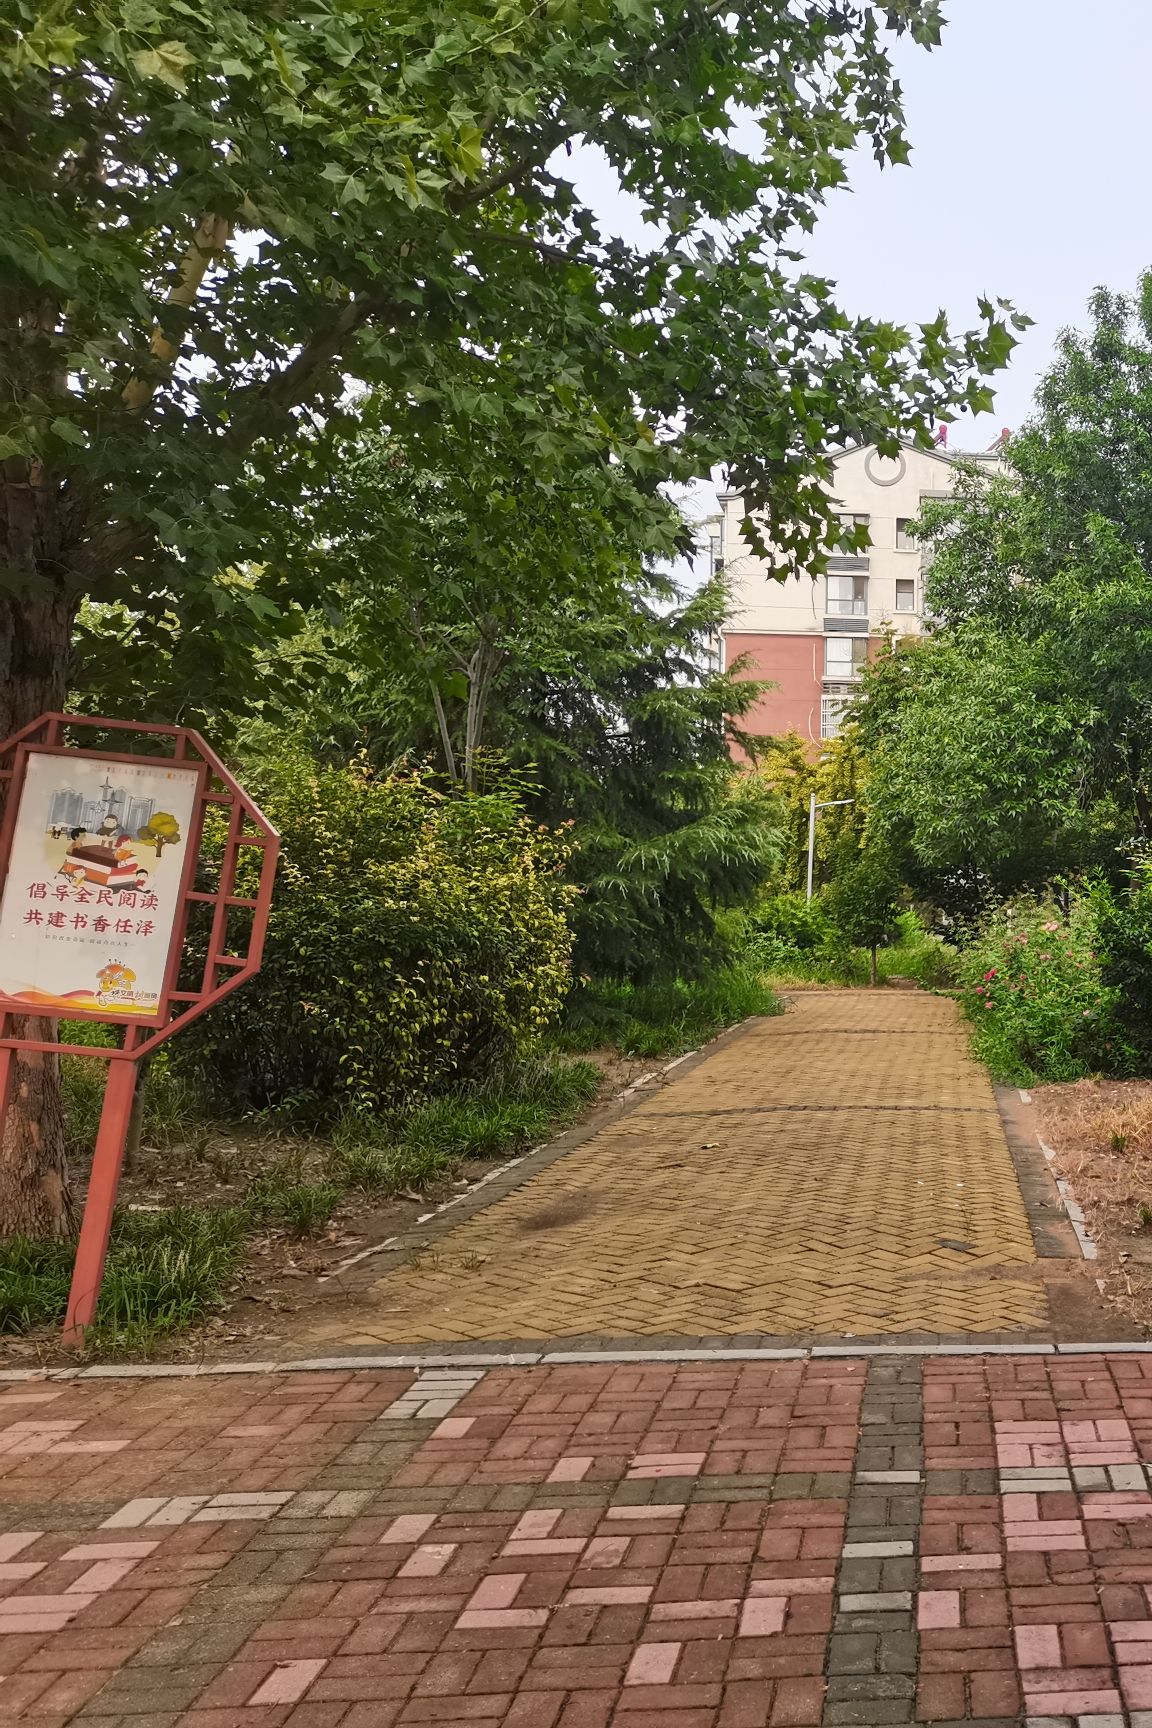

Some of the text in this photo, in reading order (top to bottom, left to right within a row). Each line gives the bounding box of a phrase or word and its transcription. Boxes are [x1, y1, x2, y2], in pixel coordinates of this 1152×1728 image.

[26, 881, 159, 912] 倡导全民阅读
[22, 908, 157, 937] 共建书香任泽
